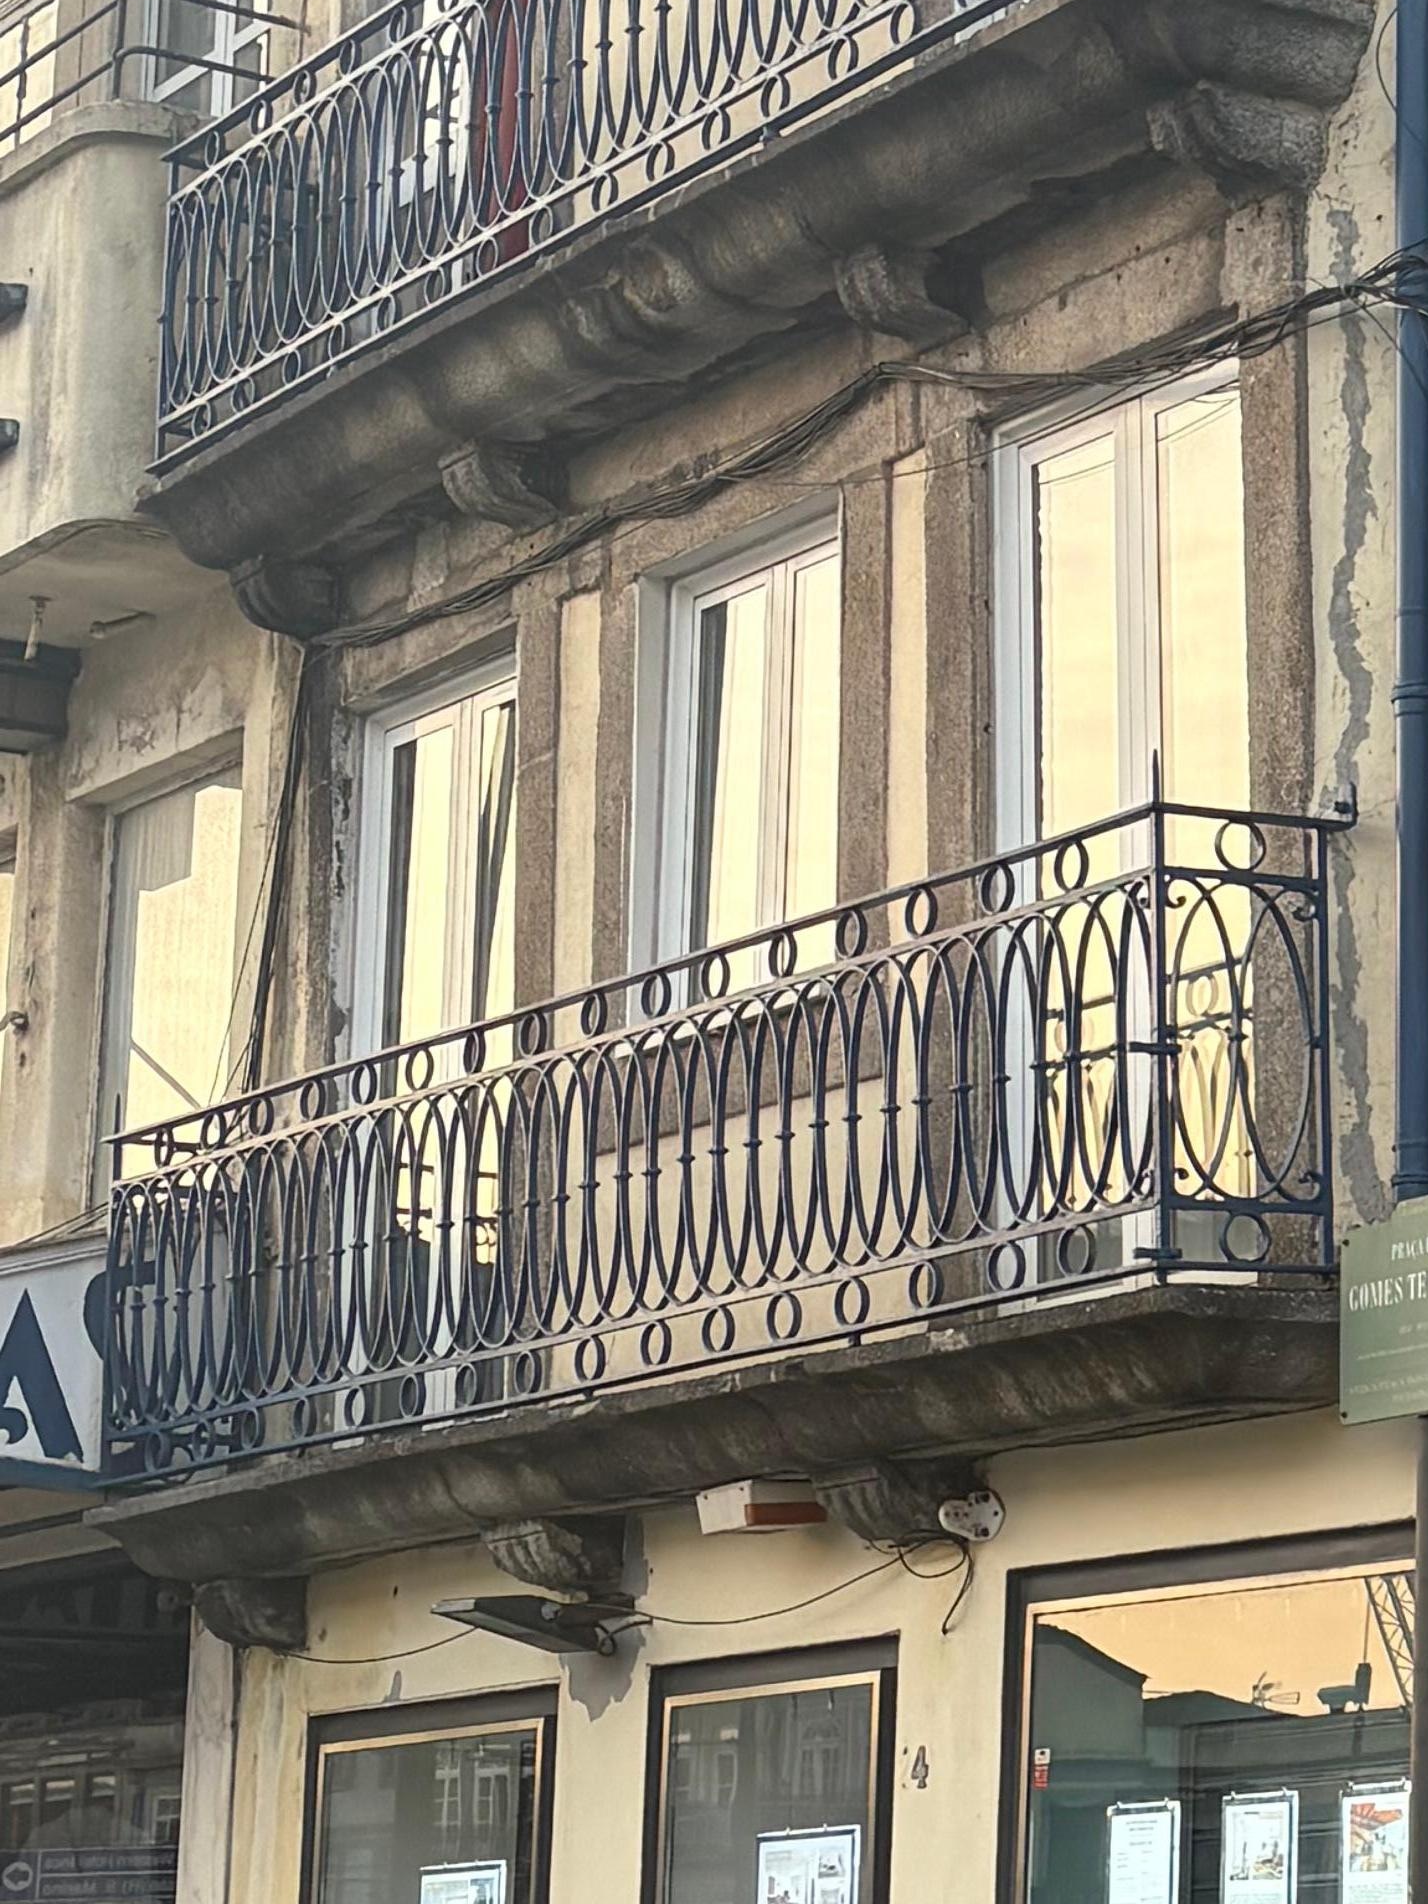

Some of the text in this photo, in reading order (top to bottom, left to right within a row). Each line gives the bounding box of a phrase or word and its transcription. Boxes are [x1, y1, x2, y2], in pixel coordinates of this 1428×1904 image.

[1391, 1239, 1424, 1261] PRAÇA
[1348, 1276, 1404, 1312] GOMES
[911, 1745, 930, 1789] 4
